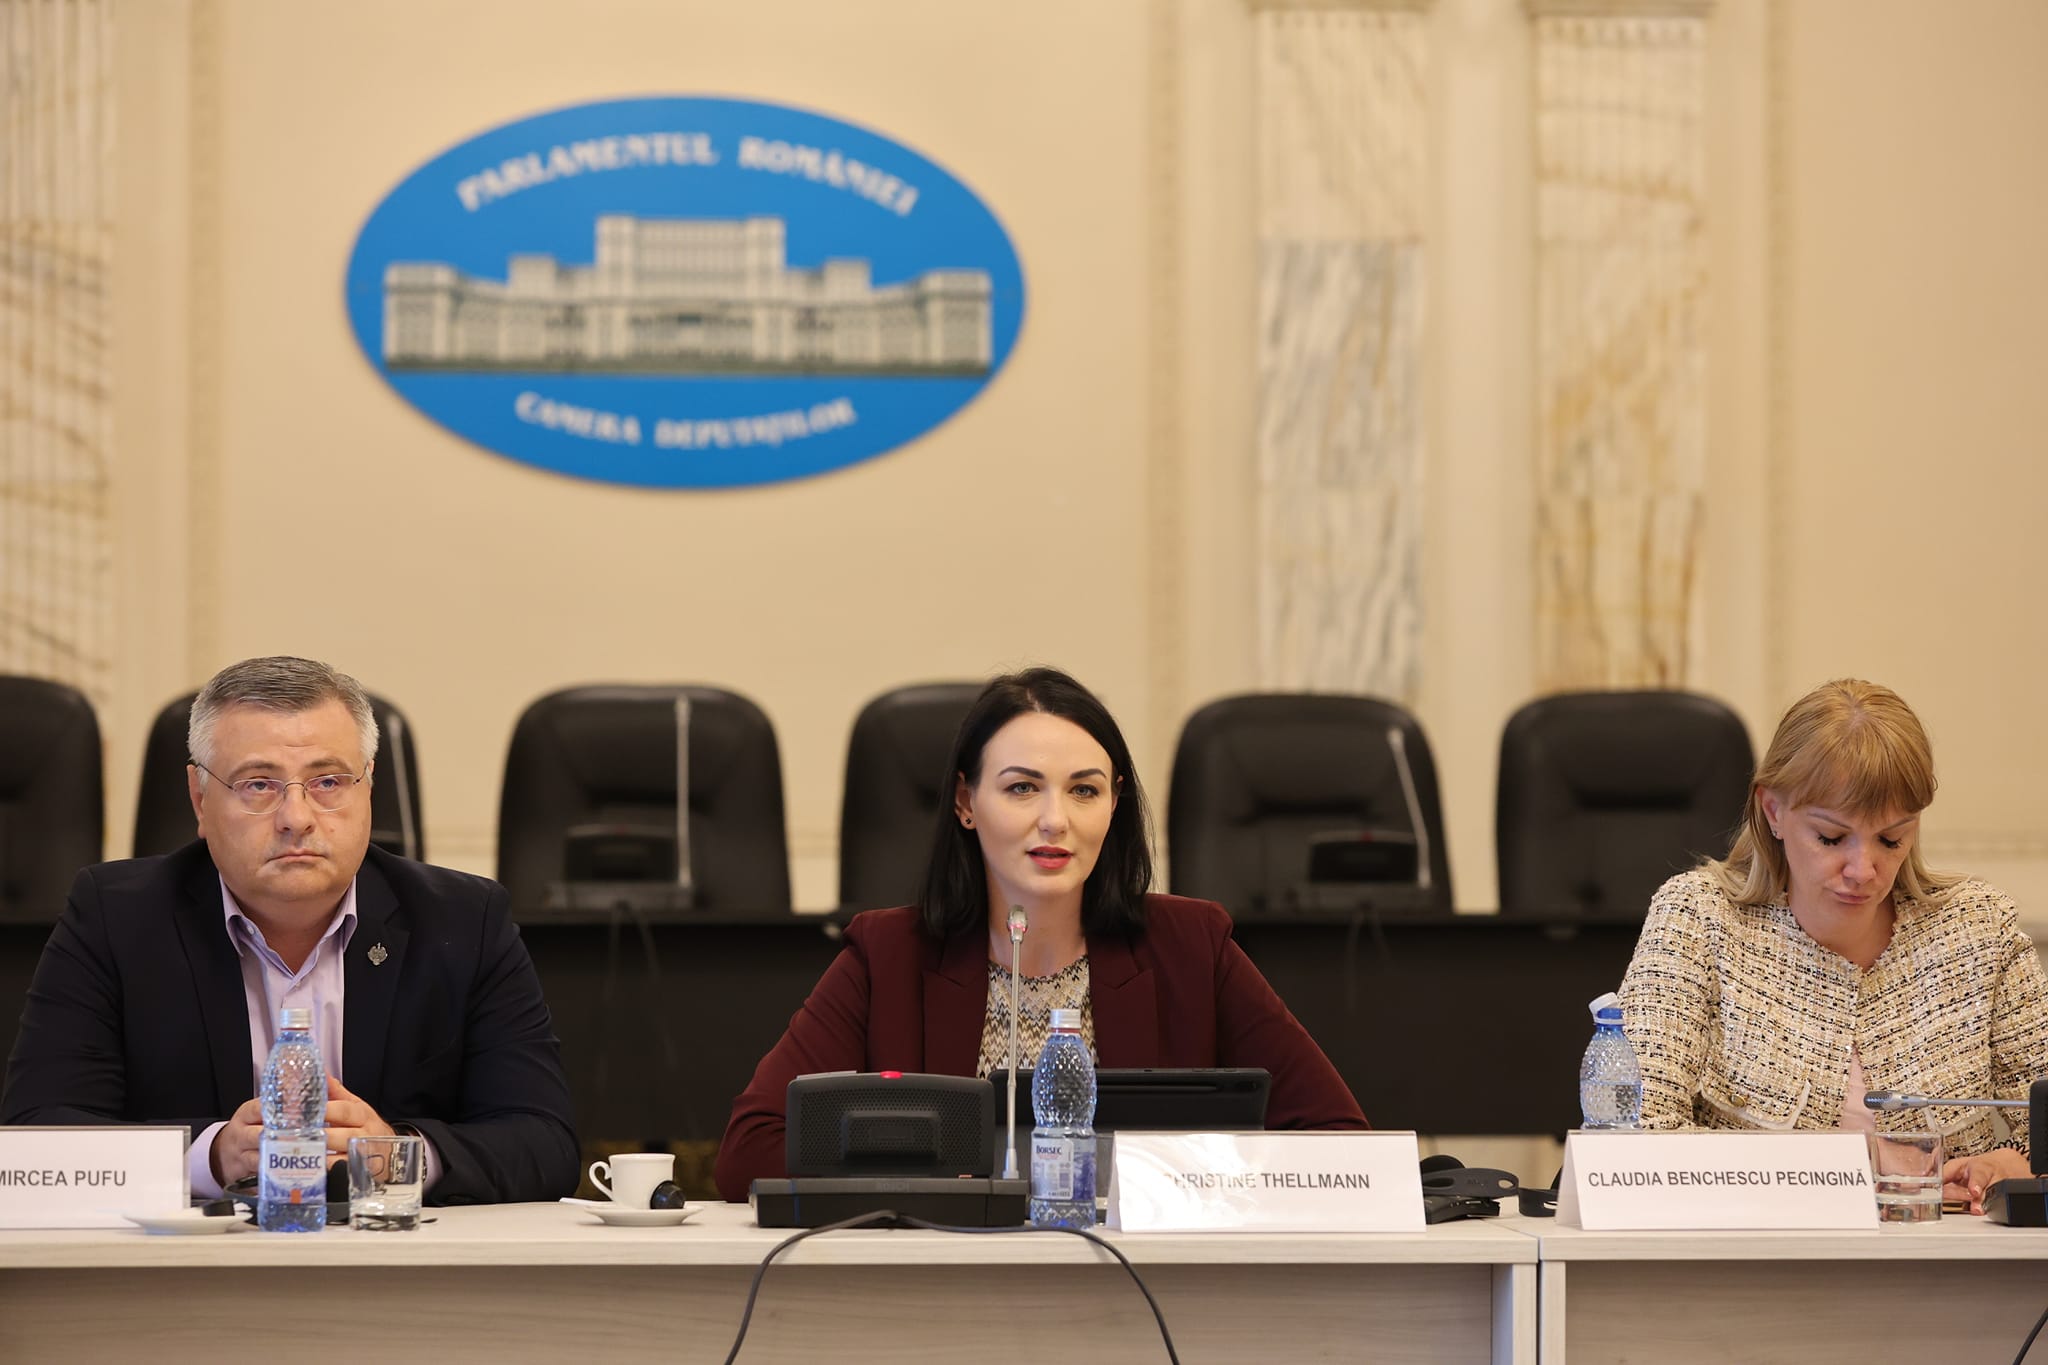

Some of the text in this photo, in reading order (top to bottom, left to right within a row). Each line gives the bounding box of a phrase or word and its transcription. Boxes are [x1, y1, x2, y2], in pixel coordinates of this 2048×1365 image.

[457, 132, 718, 211] PARLAMENTUL
[515, 391, 642, 446] CAMERA
[269, 1153, 322, 1169] BORSEC
[75, 1170, 126, 1186] PUFU
[1164, 1172, 1371, 1189] HRISTINE THELLMANN
[1588, 1168, 1867, 1187] CLAUDIA BENCHESCU PECINGINĂ
